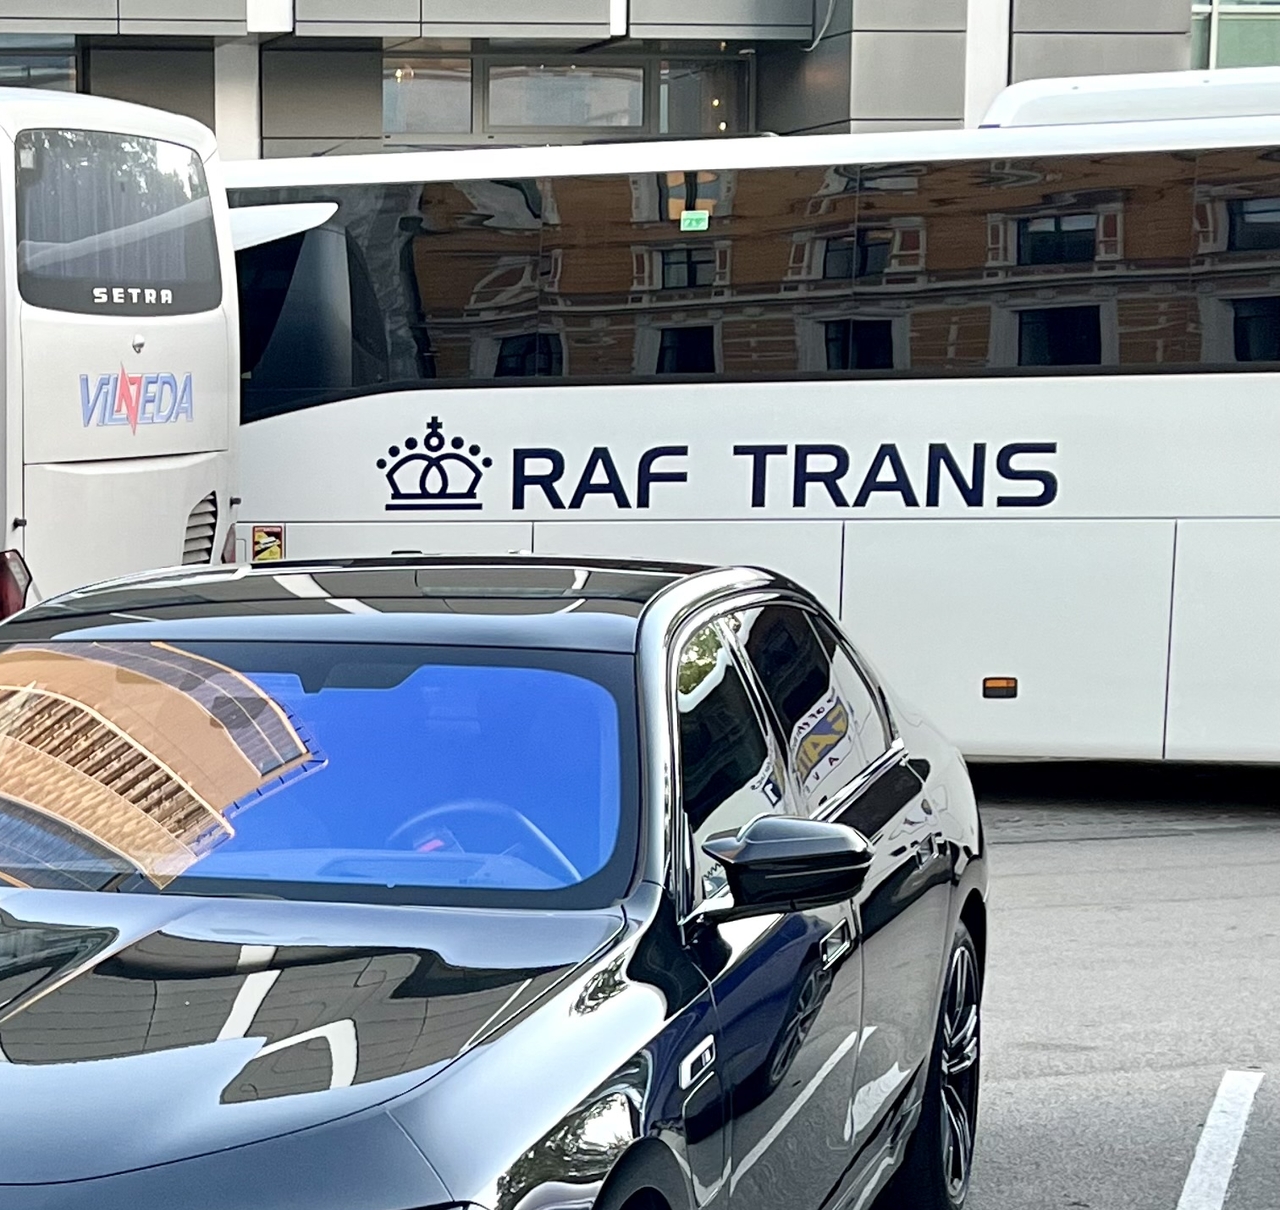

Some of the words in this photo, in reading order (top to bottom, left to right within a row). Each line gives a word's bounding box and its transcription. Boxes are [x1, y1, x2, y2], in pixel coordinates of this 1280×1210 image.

[93, 287, 173, 304] SETRA
[512, 446, 689, 510] RAF
[732, 442, 1058, 508] TRANS
